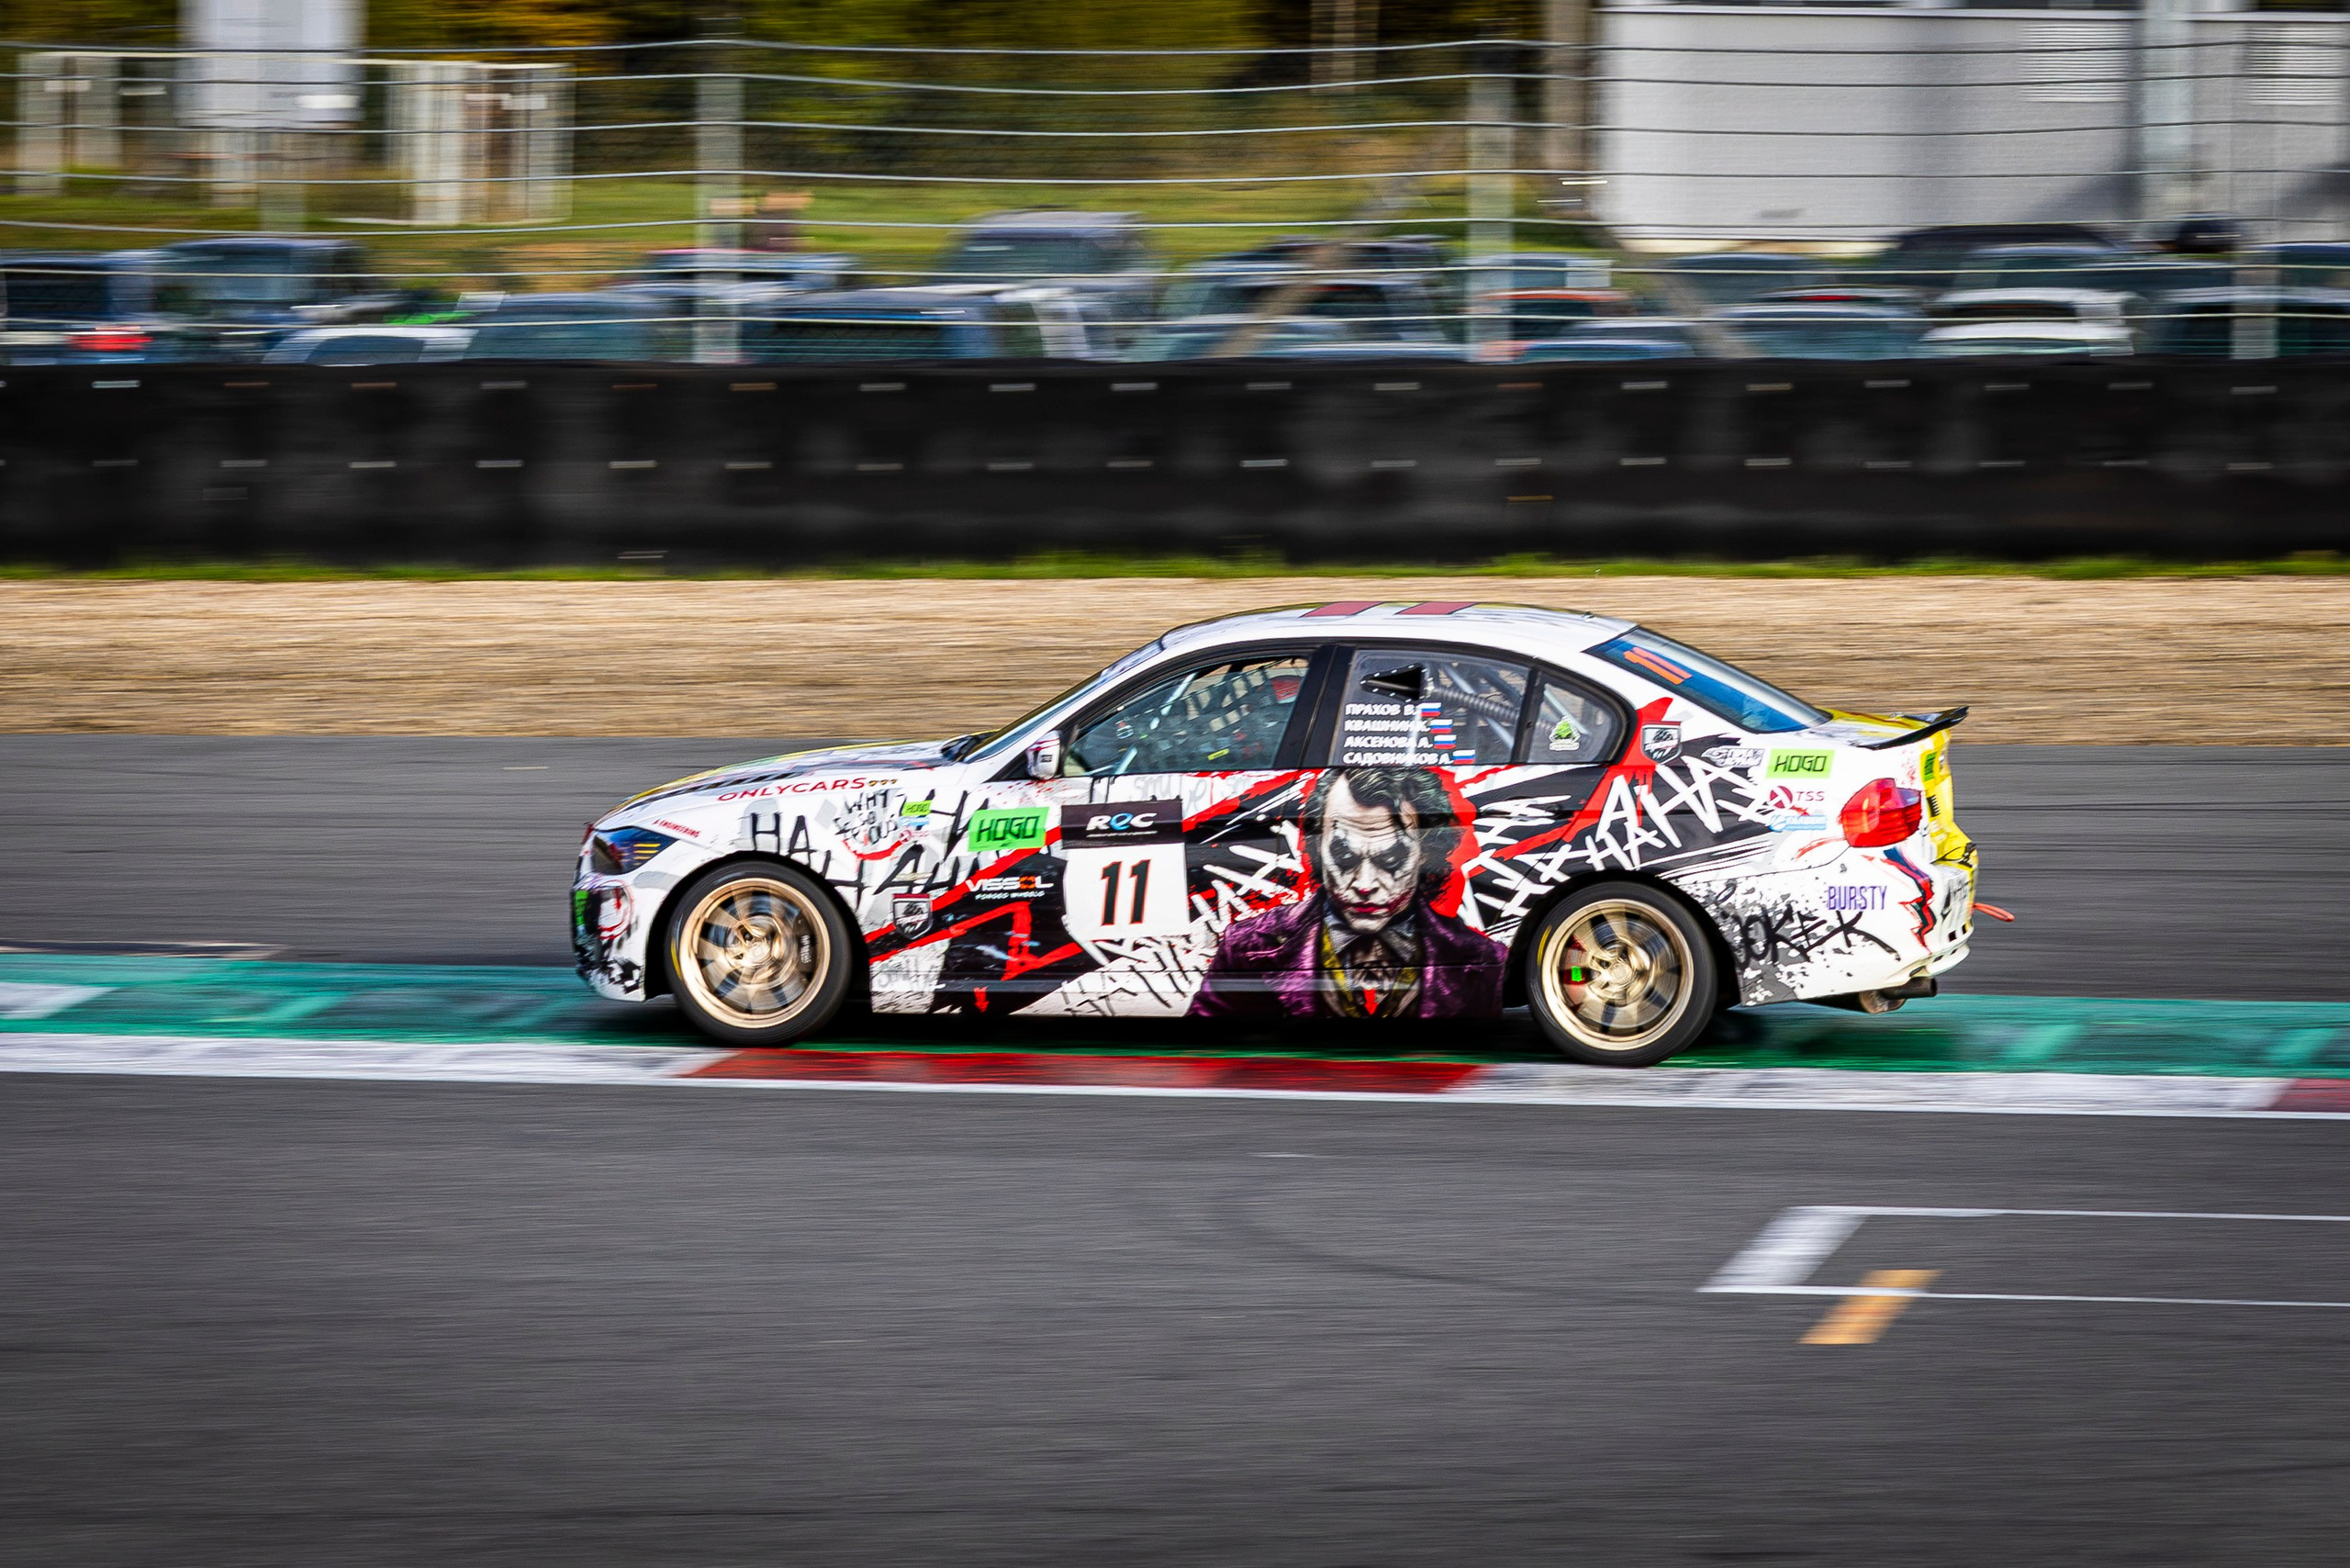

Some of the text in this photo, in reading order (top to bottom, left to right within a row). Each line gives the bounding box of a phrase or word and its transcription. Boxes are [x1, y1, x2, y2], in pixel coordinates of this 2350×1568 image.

[1345, 703, 1401, 716] ПРАХОВ
[1774, 755, 1828, 772] HOGO
[717, 777, 867, 801] ONLYCARS
[1796, 790, 1825, 801] TSS
[976, 815, 1041, 842] HOGO
[1101, 859, 1151, 926] 11
[1828, 885, 1887, 910] BURSTY
